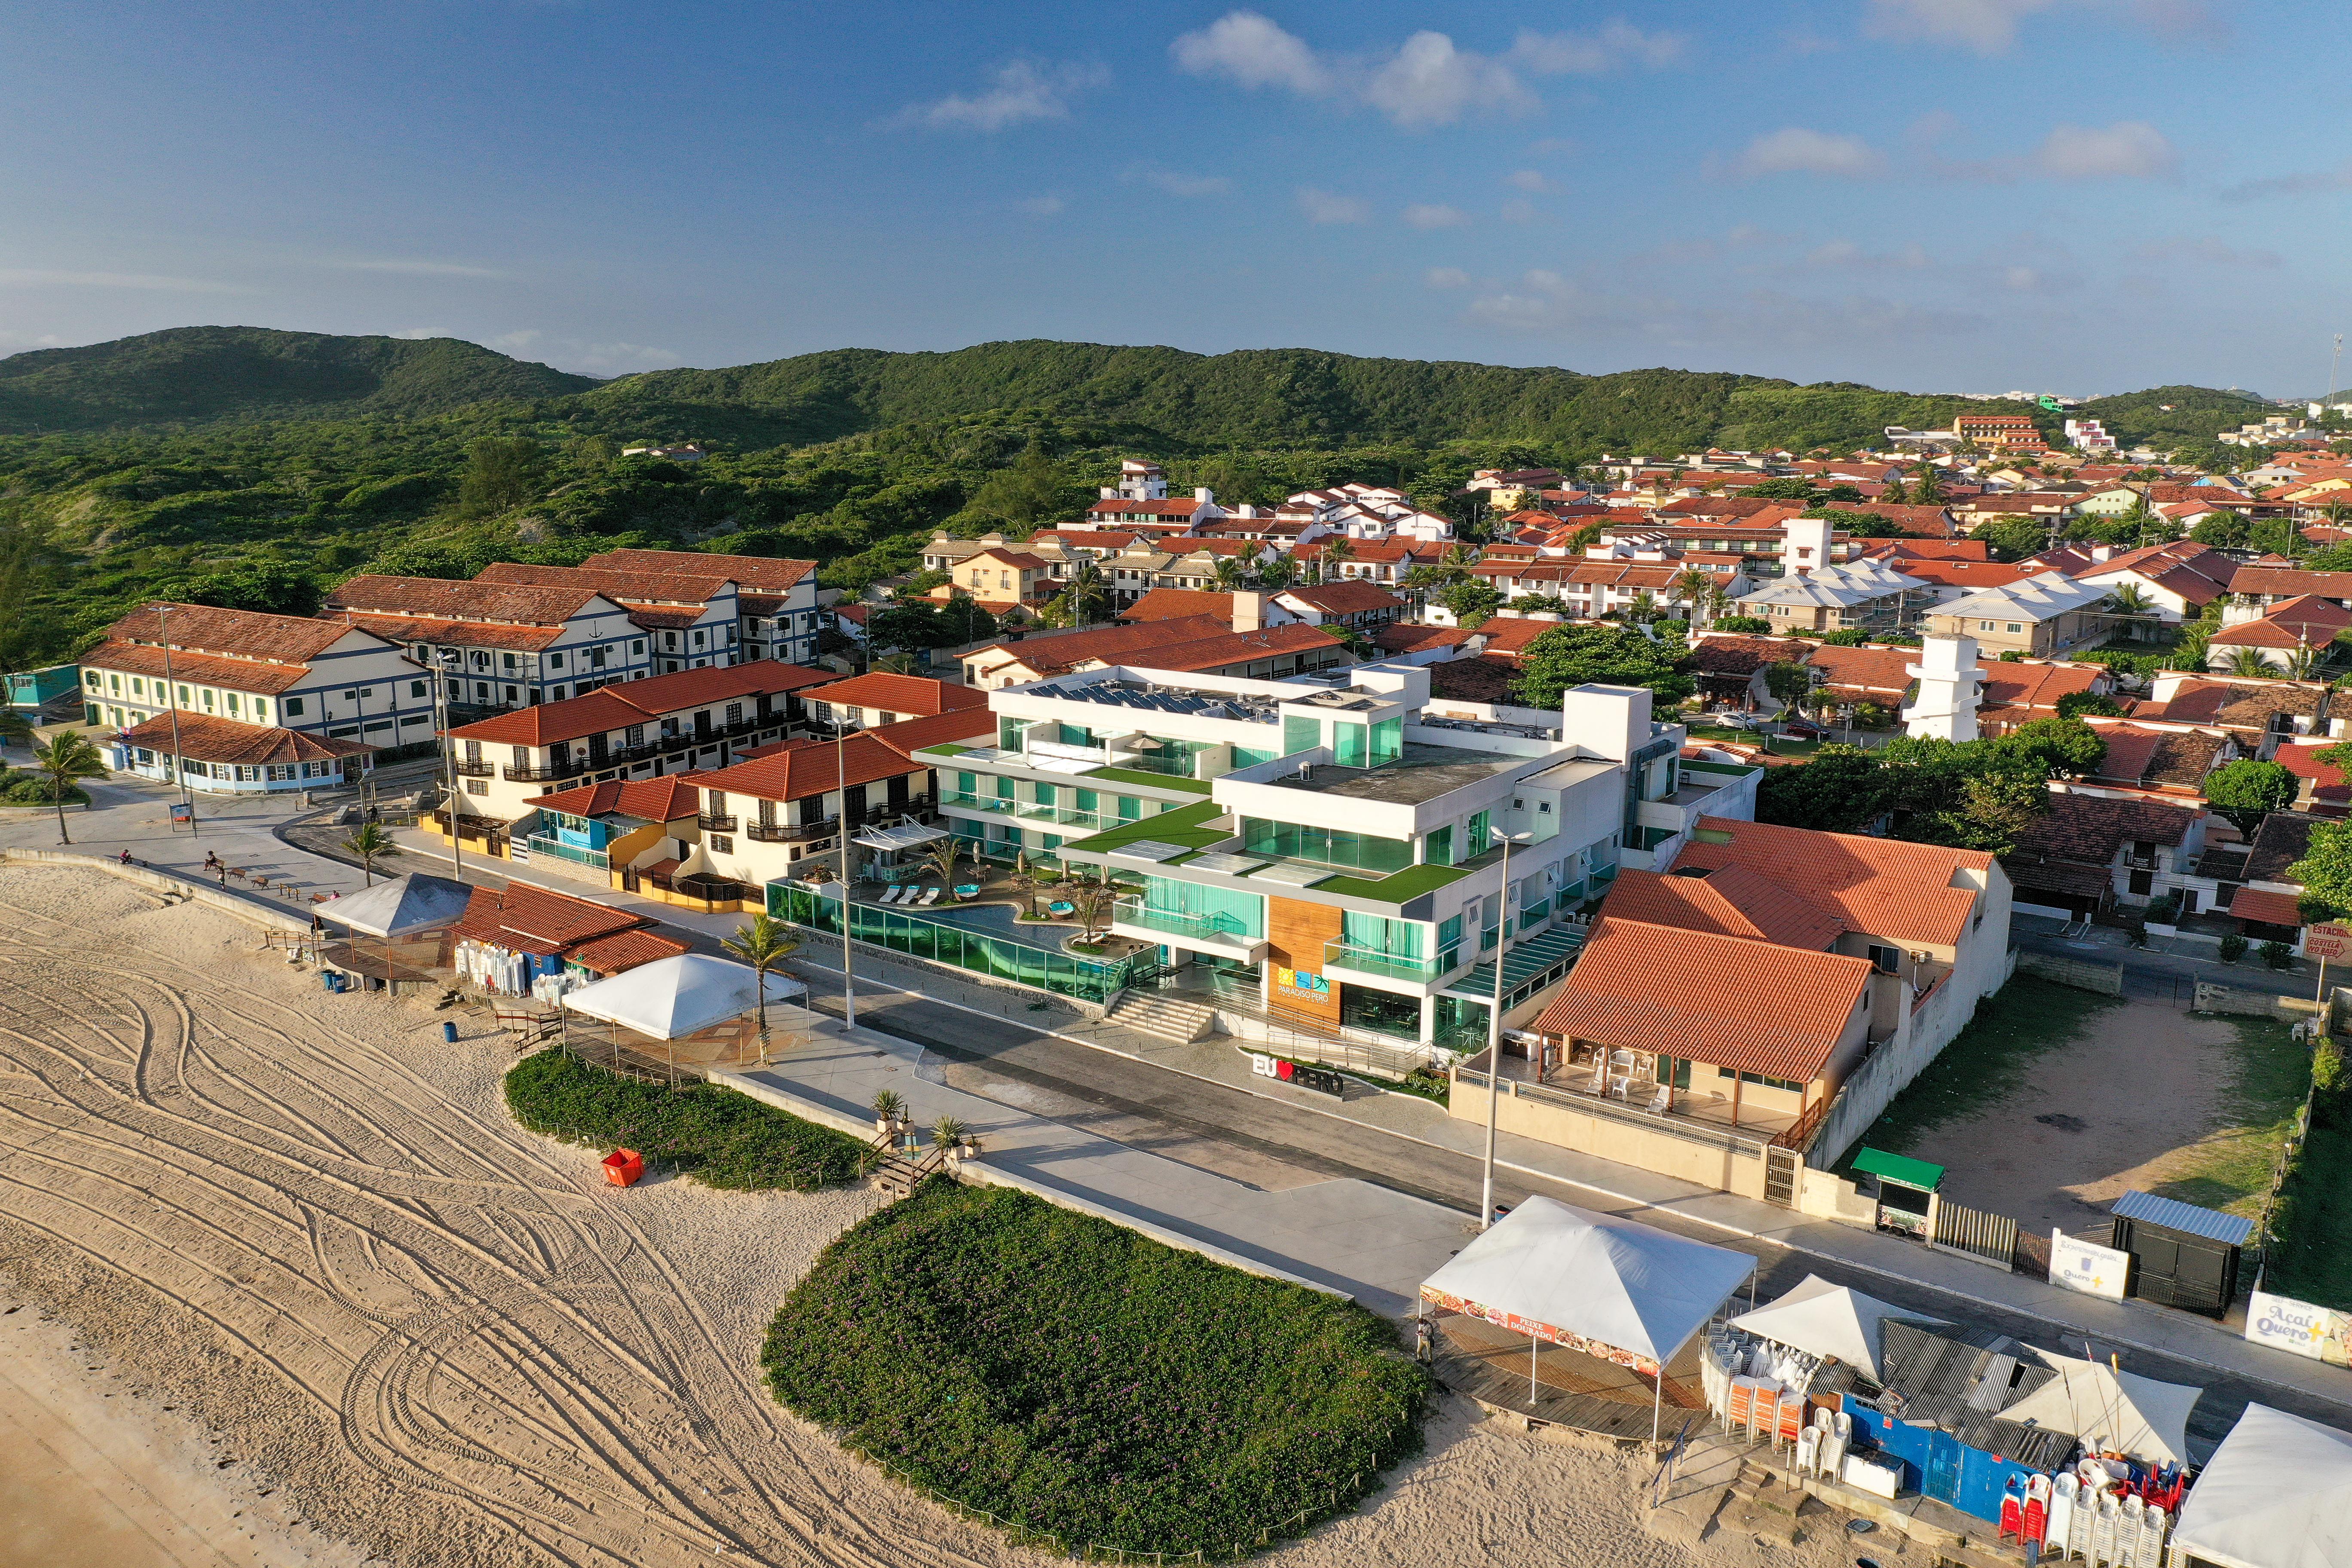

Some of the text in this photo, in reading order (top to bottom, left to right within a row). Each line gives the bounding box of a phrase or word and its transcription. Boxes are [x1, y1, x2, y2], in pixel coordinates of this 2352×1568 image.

[2309, 939, 2340, 949] COSTELA
[1278, 985, 1329, 1002] PARADISO PERÓ
[1253, 1053, 1343, 1096] EU PERÓ
[2063, 1269, 2090, 1282] Quero
[1519, 1317, 1543, 1330] PEIXE
[2269, 1306, 2313, 1328] Açaí
[1511, 1321, 1552, 1340] DOURADO
[2257, 1318, 2310, 1341] Quero
